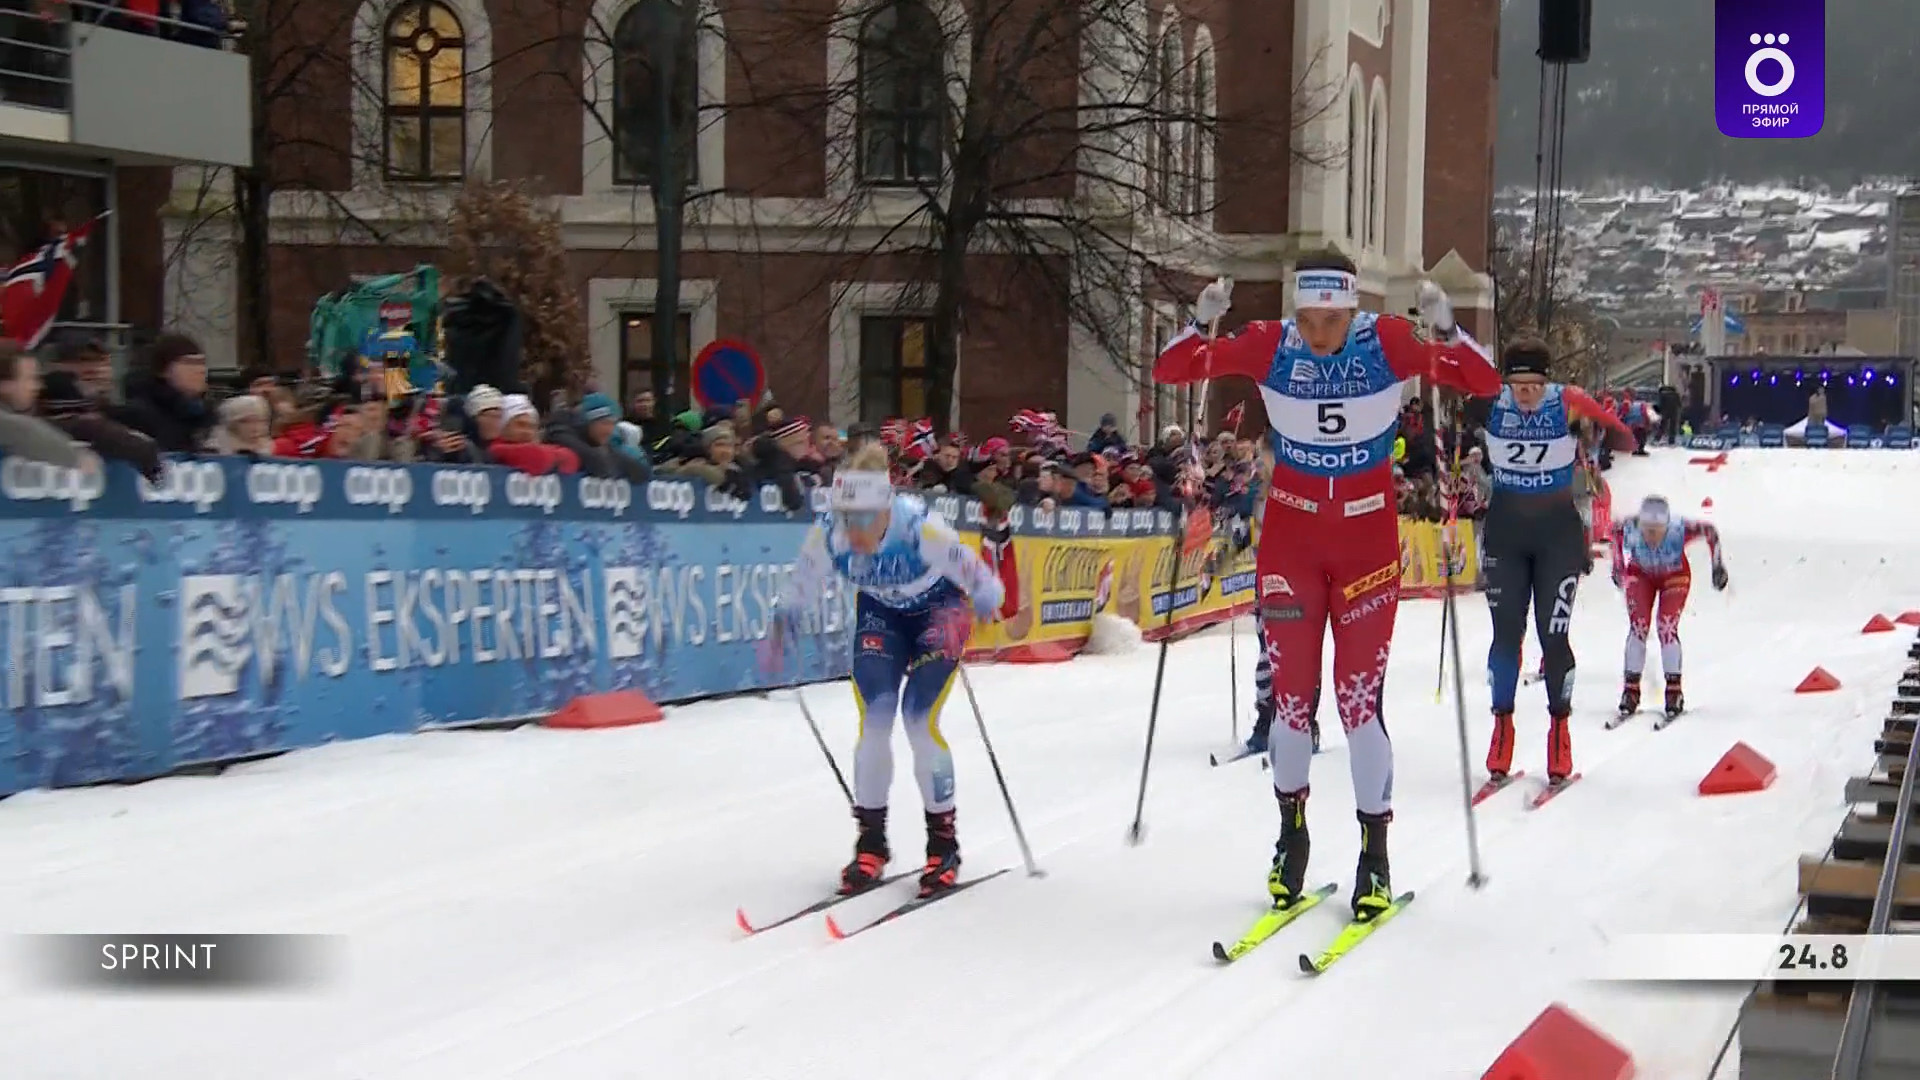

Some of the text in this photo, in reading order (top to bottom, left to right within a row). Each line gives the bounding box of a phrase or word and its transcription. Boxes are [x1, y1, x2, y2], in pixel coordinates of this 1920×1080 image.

[1321, 355, 1367, 381] VVS
[1289, 379, 1371, 396] EKSPERTEN
[1318, 403, 1347, 434] 5
[1281, 437, 1370, 468] Resorb
[1506, 442, 1550, 465] 27
[247, 462, 323, 513] coop
[344, 466, 413, 514] coop
[432, 470, 491, 514] coop
[505, 472, 562, 514] coop
[579, 476, 631, 517] coop
[647, 480, 695, 519] coop
[1494, 468, 1553, 487] Resorb
[365, 567, 597, 671] EKSPERTEN
[1341, 592, 1390, 624] CRAFT
[1548, 575, 1577, 634] CZE
